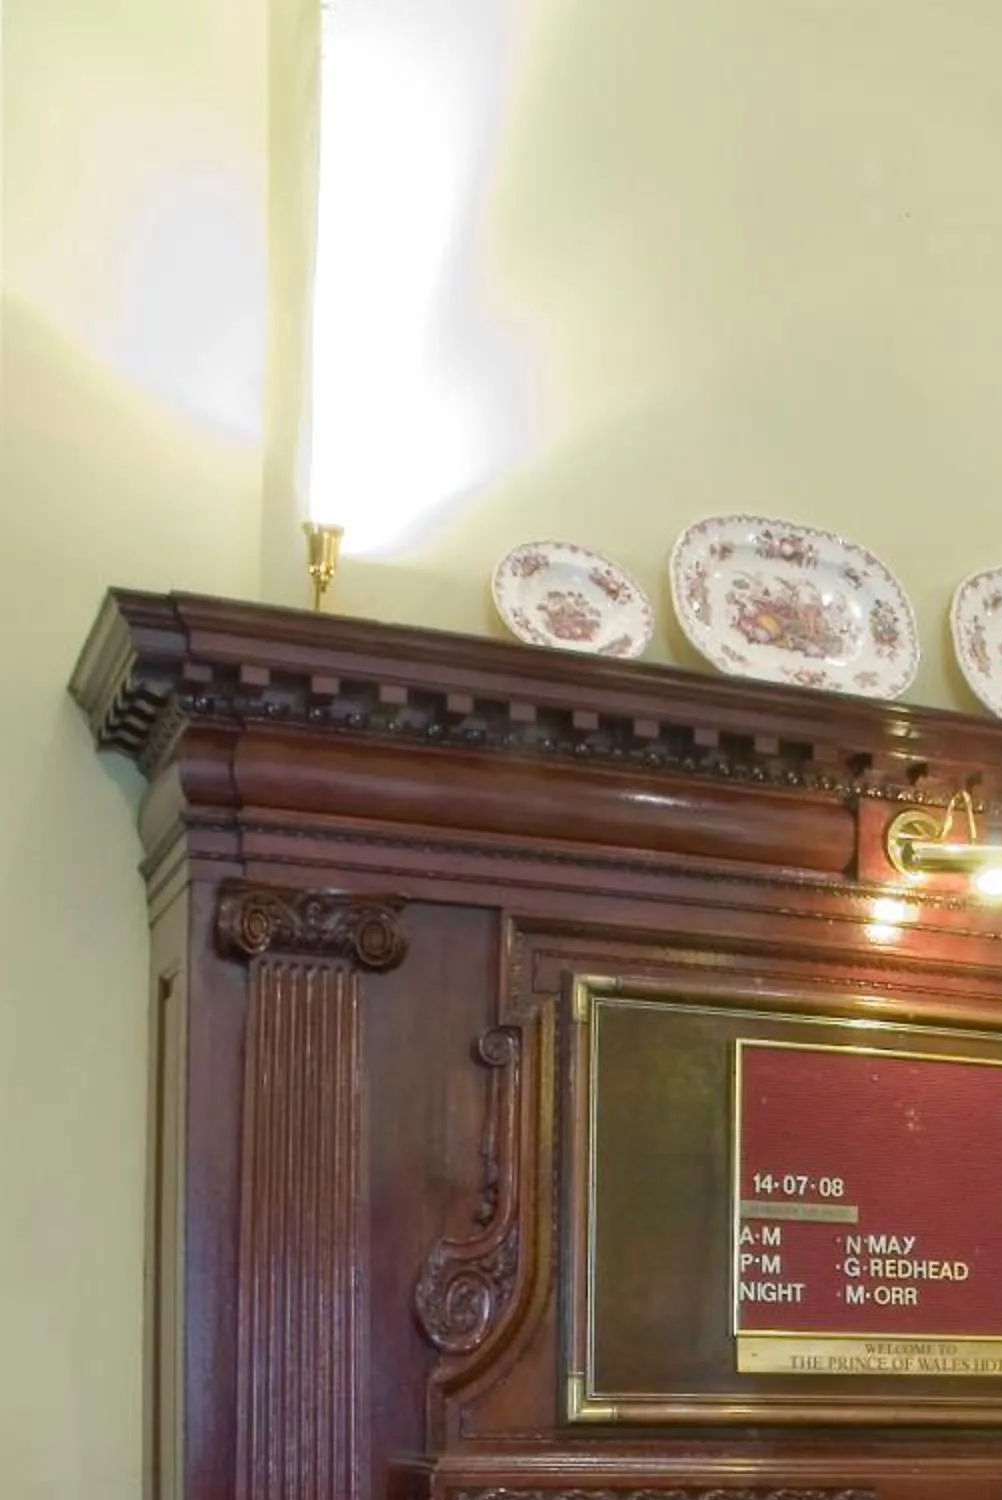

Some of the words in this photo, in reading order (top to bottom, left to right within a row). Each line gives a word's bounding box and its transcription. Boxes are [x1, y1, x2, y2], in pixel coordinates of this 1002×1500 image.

[740, 1280, 806, 1303] NIGHT
[864, 1343, 931, 1355] WELCOME
[938, 1344, 958, 1356] TO
[789, 1355, 825, 1371] THE
[828, 1355, 891, 1372] PRINCE
[892, 1357, 914, 1371] OF
[916, 1358, 971, 1373] WALES
